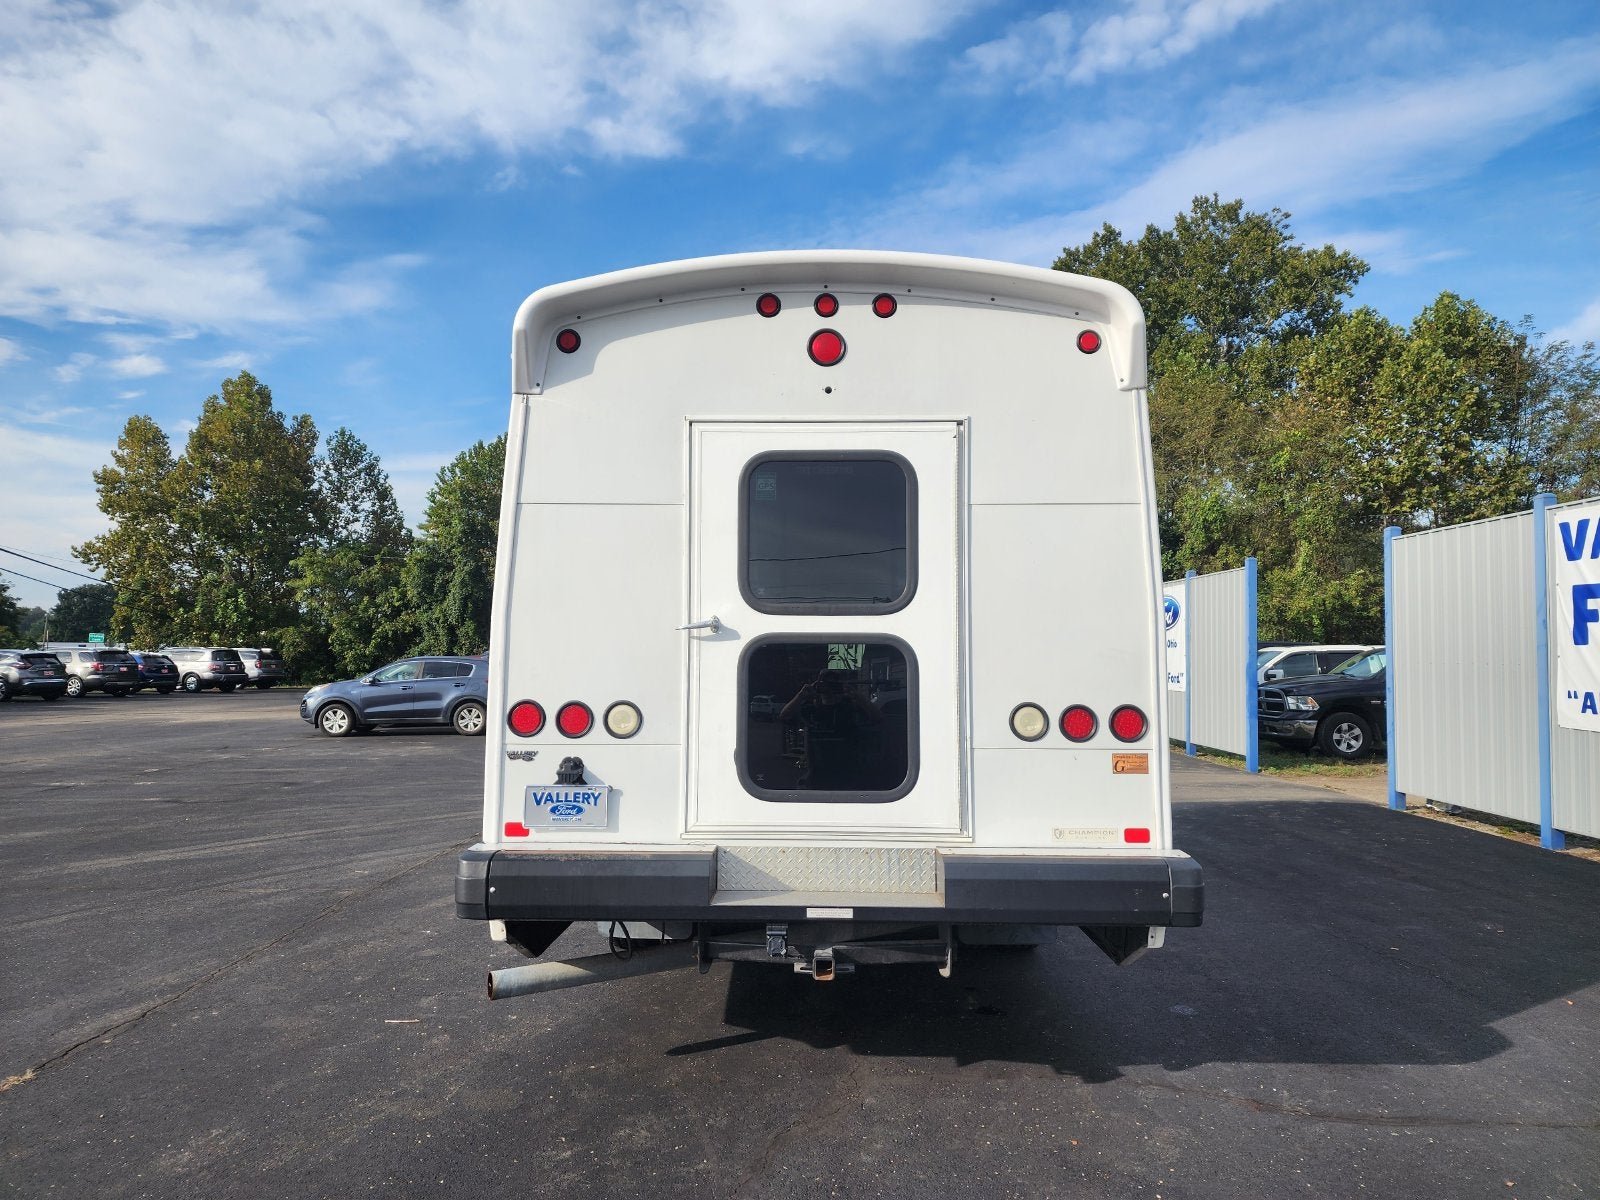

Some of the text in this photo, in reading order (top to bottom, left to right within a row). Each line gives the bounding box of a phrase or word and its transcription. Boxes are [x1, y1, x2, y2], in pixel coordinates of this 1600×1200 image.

[1572, 583, 1600, 645] F
[1114, 760, 1125, 772] G
[532, 792, 601, 806] VALLERY
[555, 805, 578, 814] Ford
